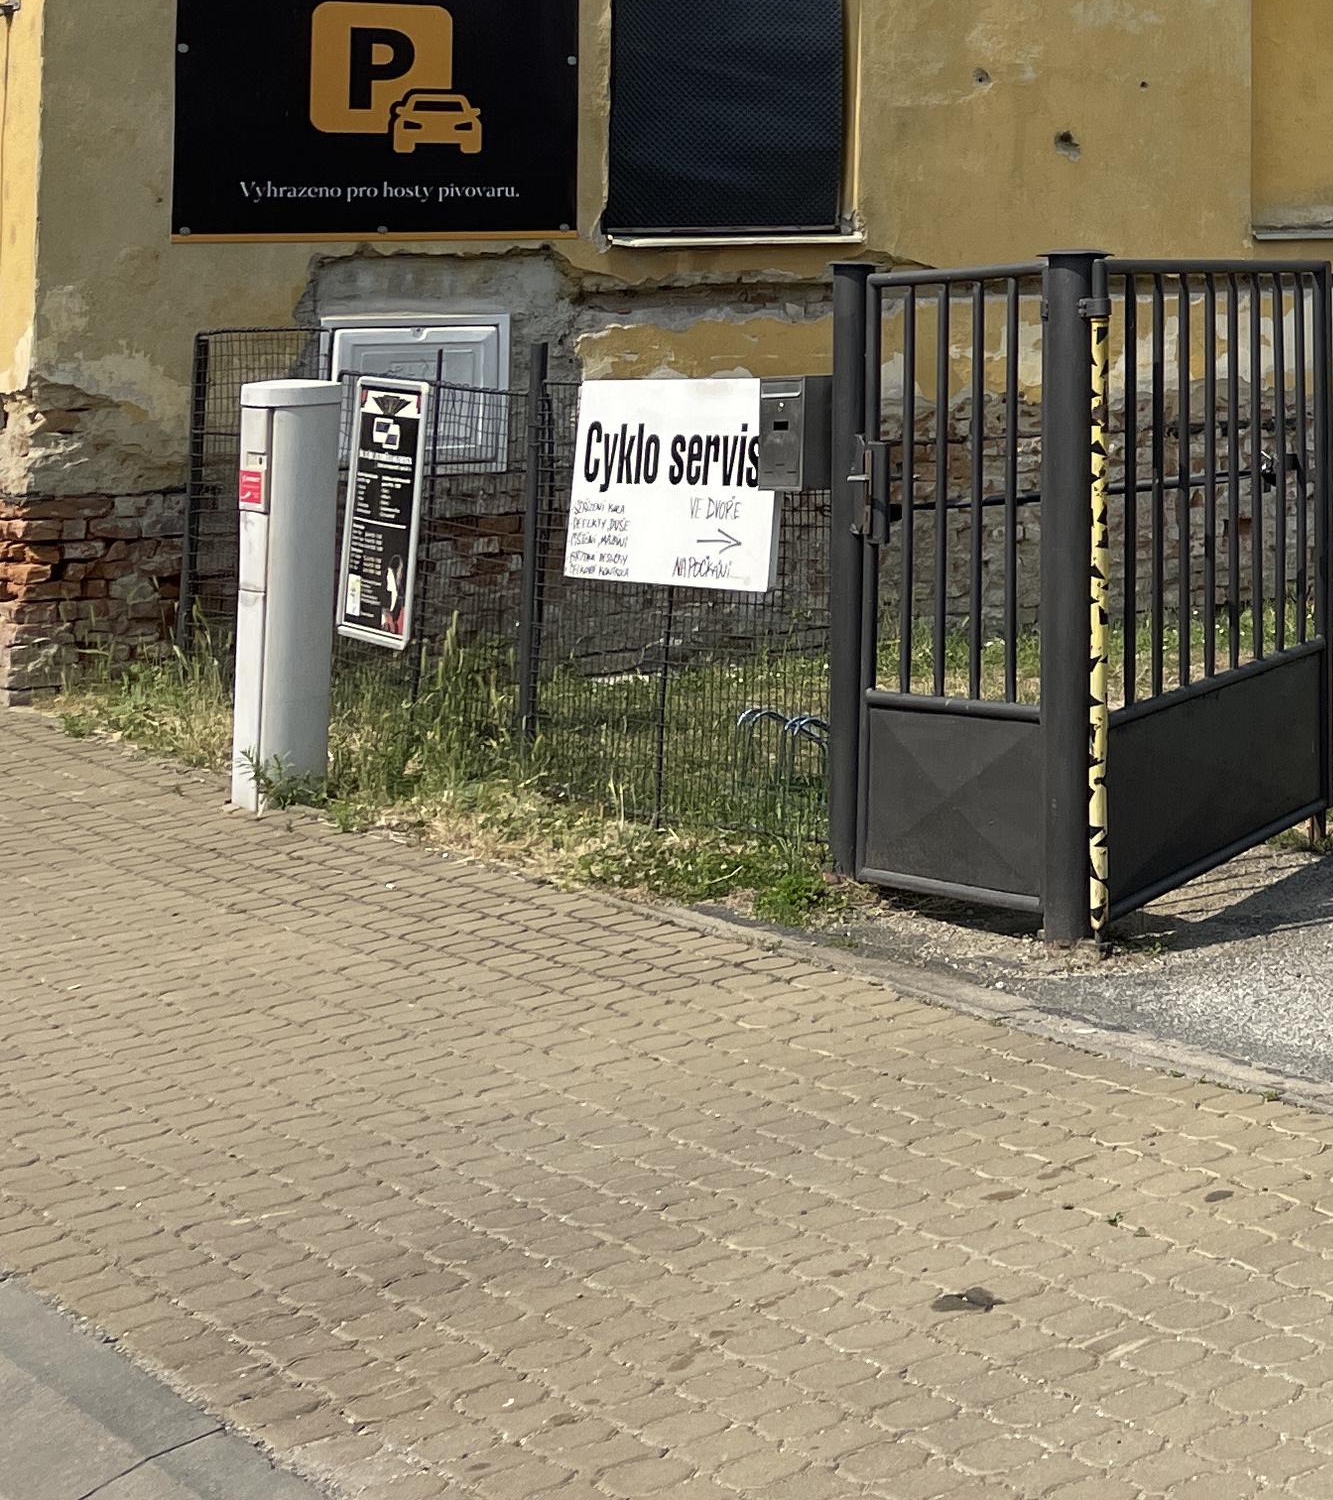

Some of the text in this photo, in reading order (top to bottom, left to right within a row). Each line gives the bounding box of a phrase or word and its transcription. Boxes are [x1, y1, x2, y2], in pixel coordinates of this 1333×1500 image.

[240, 181, 520, 203] Vyhrazeno pro hosty pivovaru.
[584, 421, 760, 492] Cyklo servis
[690, 496, 743, 520] VE DVOŘE
